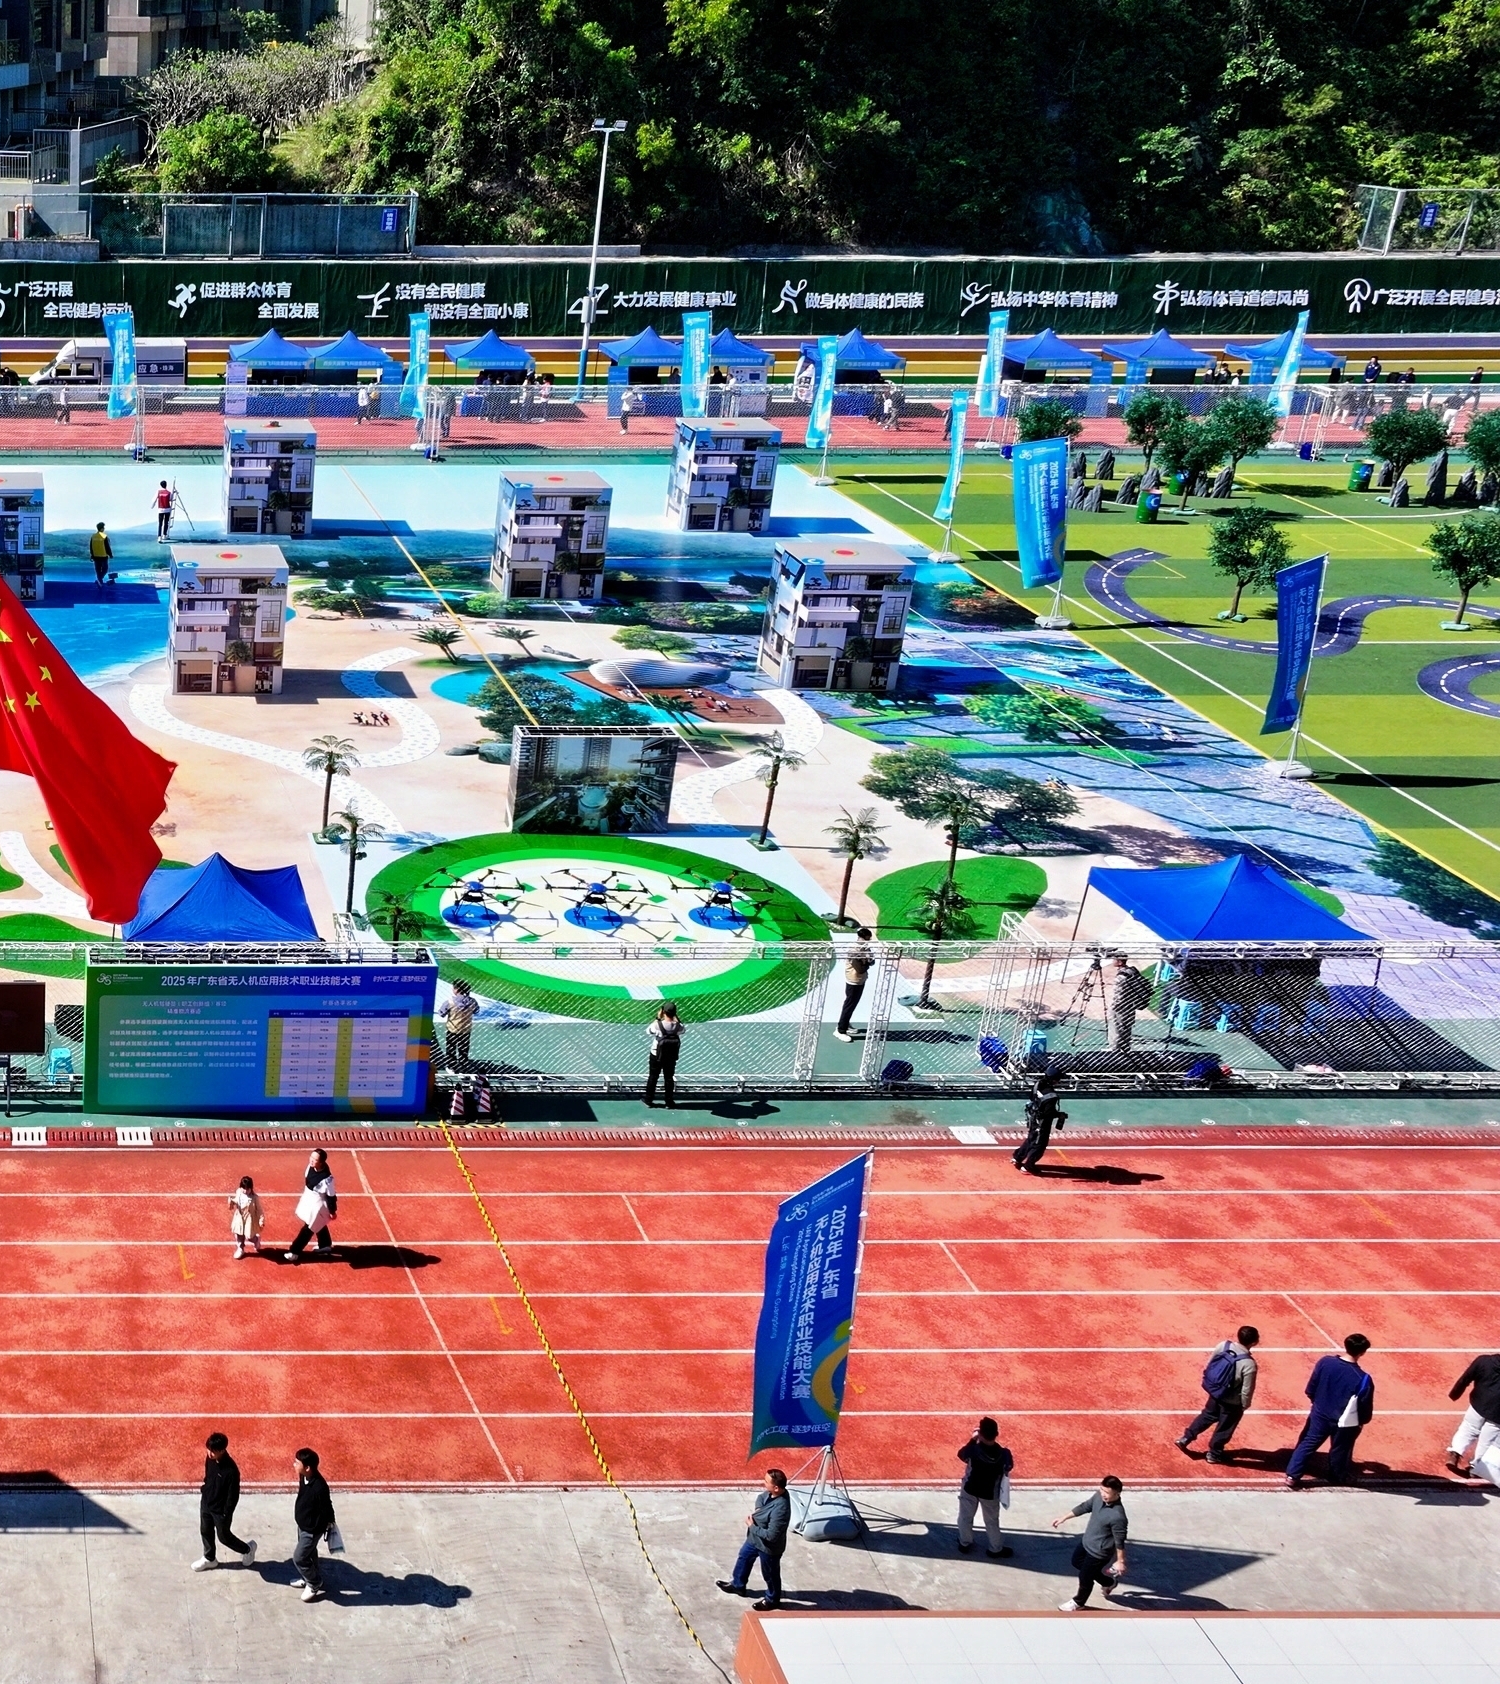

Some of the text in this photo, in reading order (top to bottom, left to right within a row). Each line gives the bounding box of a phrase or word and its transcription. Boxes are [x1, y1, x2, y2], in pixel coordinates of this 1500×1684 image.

[13, 280, 73, 298] 广泛开展
[200, 281, 292, 299] 促进群众体育
[395, 282, 486, 300] 没有全民健康
[613, 290, 737, 308] 大力发展健康事业
[804, 291, 924, 310] 做身体健康的民族
[990, 290, 1118, 308] 弘扬中华体育精神
[1180, 289, 1309, 308] 弘扬体育道德风尚
[258, 302, 320, 320] 全面发展
[424, 302, 529, 320] 就没有全面小康
[161, 975, 361, 987] 2025年广东省无人机应用技术职业技能大赛
[372, 975, 427, 983] 时代工匠 逐梦低空
[820, 1204, 848, 1300] 2025年广东省
[791, 1213, 830, 1399] 无人机应用技术职业技能大赛
[791, 1422, 832, 1434] 逐梦低空
